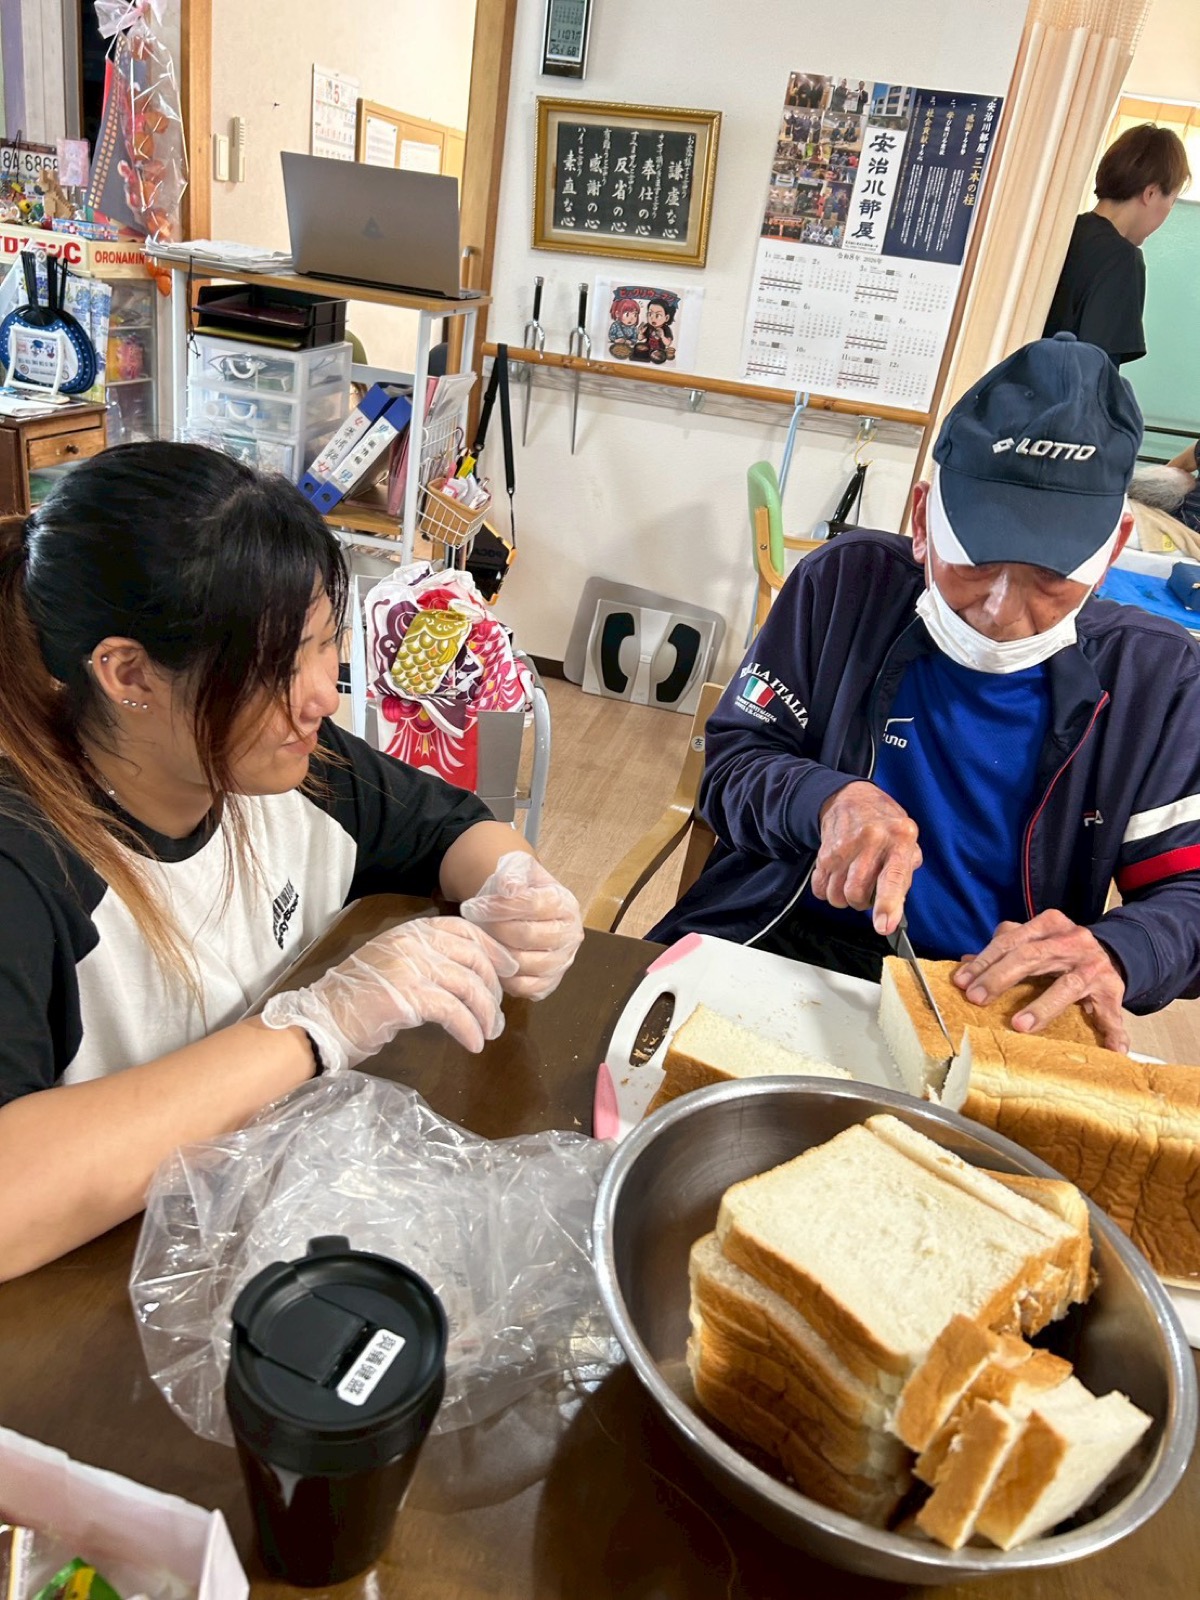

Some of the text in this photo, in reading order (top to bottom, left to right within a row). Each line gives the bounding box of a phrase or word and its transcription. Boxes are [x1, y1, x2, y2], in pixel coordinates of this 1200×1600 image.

[560, 149, 578, 228] 素直な心
[585, 153, 603, 230] 感謝の心
[610, 156, 630, 234] 反省の心
[635, 157, 657, 237] 奉仕の心
[662, 161, 684, 239] 謙虚な心
[851, 132, 897, 240] 安治川部屋
[963, 157, 983, 205] 三本の柱
[95, 250, 146, 265] ORONAMIN
[1015, 437, 1096, 461] LOTTO
[770, 677, 810, 730] ITALIA
